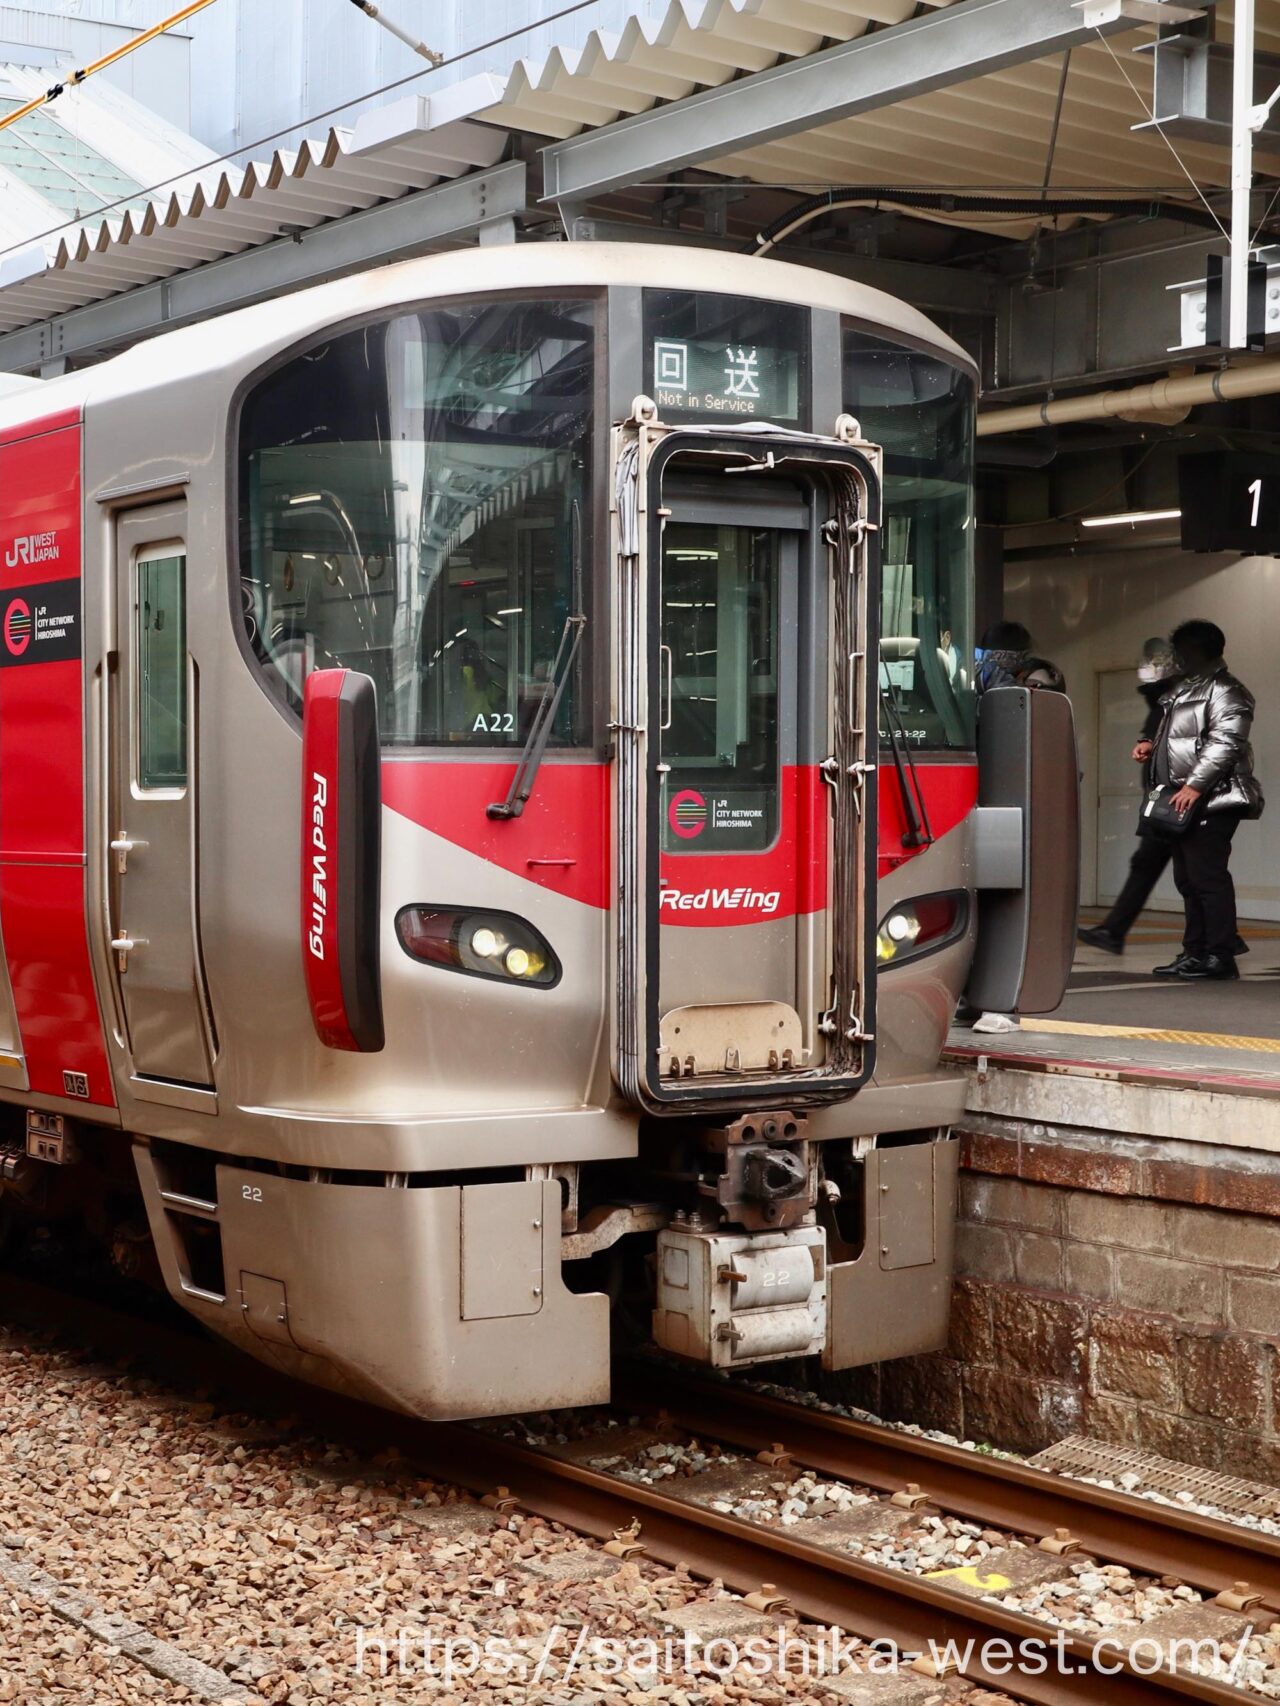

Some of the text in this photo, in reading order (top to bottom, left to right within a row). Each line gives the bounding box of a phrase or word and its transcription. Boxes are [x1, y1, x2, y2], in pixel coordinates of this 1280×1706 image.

[654, 342, 760, 397] 回送
[658, 391, 755, 413] Not in Service
[1248, 479, 1262, 527] 1
[34, 531, 56, 547] WEST
[34, 547, 60, 563] JAPAN
[38, 606, 47, 615] JR
[37, 615, 75, 628] CITY NETWORK
[37, 629, 67, 640] HIROSHIMA
[472, 713, 514, 732] A22
[717, 800, 728, 808] JR
[716, 810, 763, 818] CITY NETWORK
[716, 819, 753, 828] HIROSHIMA
[242, 1185, 262, 1202] 22
[763, 1271, 790, 1287] 22
